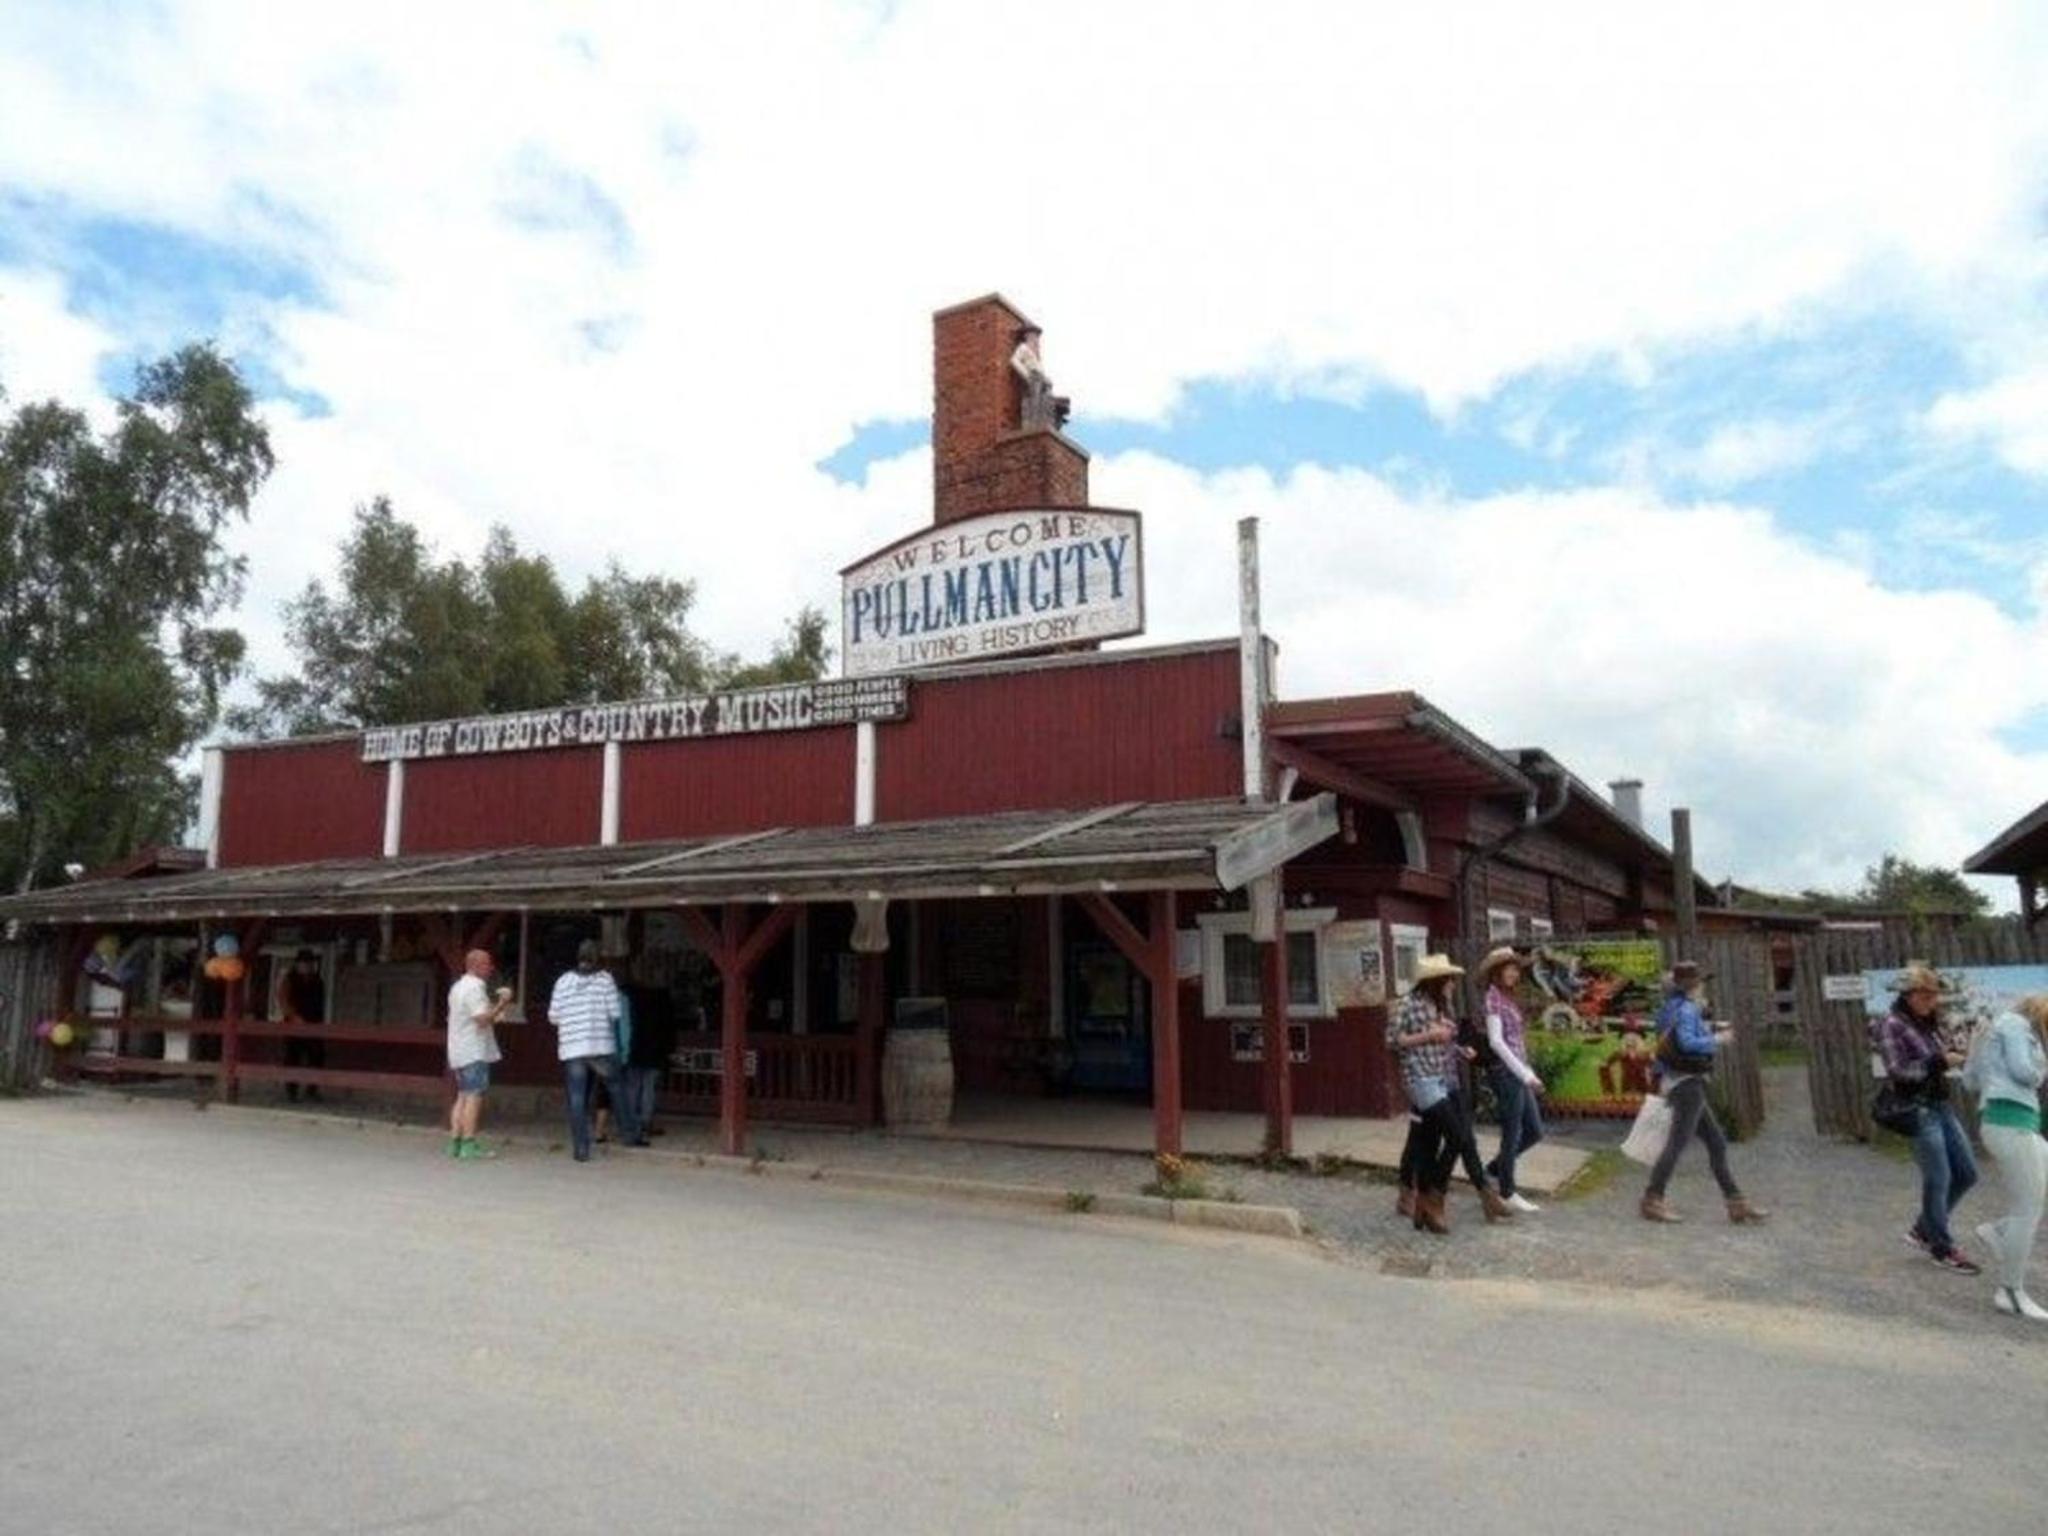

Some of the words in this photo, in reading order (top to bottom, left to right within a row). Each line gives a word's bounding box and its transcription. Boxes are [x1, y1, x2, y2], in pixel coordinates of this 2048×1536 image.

[893, 515, 1087, 572] WELCOME
[897, 633, 970, 664] LIVING
[982, 615, 1080, 651] HISTORY
[362, 727, 421, 762] HOME
[424, 723, 452, 757] OF
[455, 709, 563, 753] COWBOYS
[579, 698, 711, 744] COUNTRY
[716, 684, 814, 733] MUSIC
